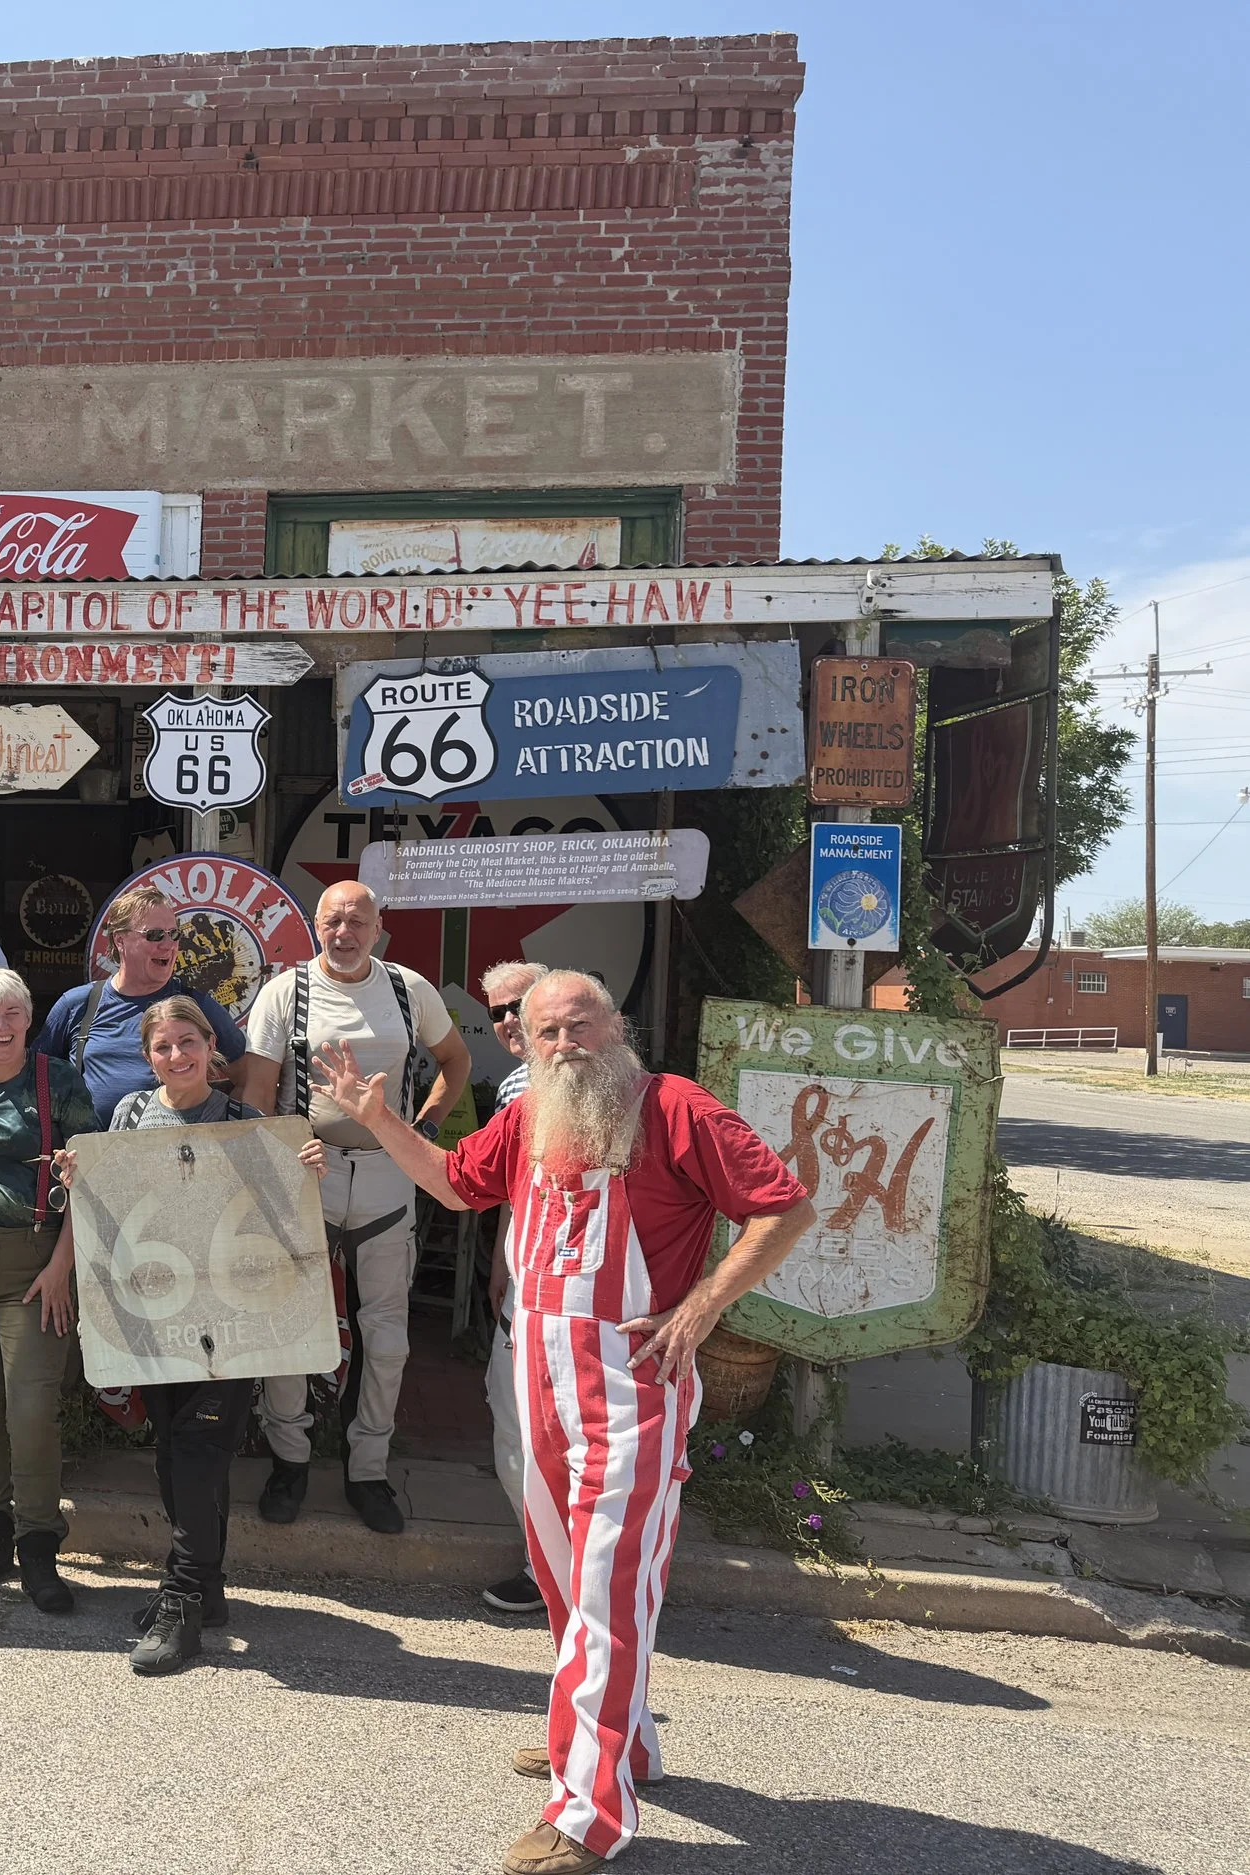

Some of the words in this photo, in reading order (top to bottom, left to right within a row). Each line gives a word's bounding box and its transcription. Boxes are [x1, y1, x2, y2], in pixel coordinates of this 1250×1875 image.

[79, 371, 667, 465] MARKET.
[360, 545, 402, 571] ROYAL
[147, 590, 198, 631] OF
[212, 588, 290, 630] THE
[503, 582, 588, 626] YEE
[381, 680, 472, 706] ROUTE
[831, 675, 895, 704] IRON
[167, 709, 245, 727] OKLAHOMA
[513, 690, 670, 730] ROADSIDE
[819, 719, 905, 751] WHEELS
[380, 711, 478, 787] 66
[513, 737, 710, 777] ATTRACTION
[176, 754, 231, 796] 66
[816, 766, 904, 789] PROHIBITED
[396, 844, 456, 858] SANDHILLS
[459, 842, 520, 855] CURIOSITY
[523, 840, 557, 853] SHOP,
[561, 839, 598, 852] ERICK,
[830, 834, 883, 846] ROADSIDE
[405, 859, 444, 870] Formerly
[445, 858, 460, 868] the
[461, 857, 479, 868] City
[481, 857, 503, 867] Meat
[540, 854, 556, 864] this
[558, 854, 567, 864] is
[569, 853, 599, 863] known
[600, 854, 611, 862] as
[613, 852, 628, 862] the
[630, 851, 658, 861] oldest
[819, 848, 893, 860] MANAGEMENT
[388, 871, 410, 881] brick
[412, 869, 447, 881] building
[448, 869, 457, 879] in
[459, 868, 484, 878] Erick.
[486, 867, 494, 877] It
[494, 867, 502, 877] is
[504, 867, 523, 877] now
[525, 866, 540, 876] the
[541, 865, 567, 875] home
[569, 865, 579, 874] of
[581, 864, 609, 875] Harley
[611, 863, 628, 873] and
[485, 878, 527, 888] Mediocre
[528, 876, 556, 887] Music
[381, 894, 418, 904] Recognized
[419, 894, 427, 903] by
[428, 893, 457, 903] Hampton
[538, 890, 567, 899] program
[583, 889, 596, 897] site
[596, 888, 616, 896] worth
[617, 888, 639, 897] seeing
[734, 1015, 814, 1057] We
[833, 1023, 969, 1069] Give
[110, 1190, 310, 1321] 66
[795, 1235, 917, 1263] REEN
[780, 1258, 917, 1290] TAMPS
[1087, 1404, 1134, 1414] Pascal
[1086, 1430, 1135, 1441] Fournier
